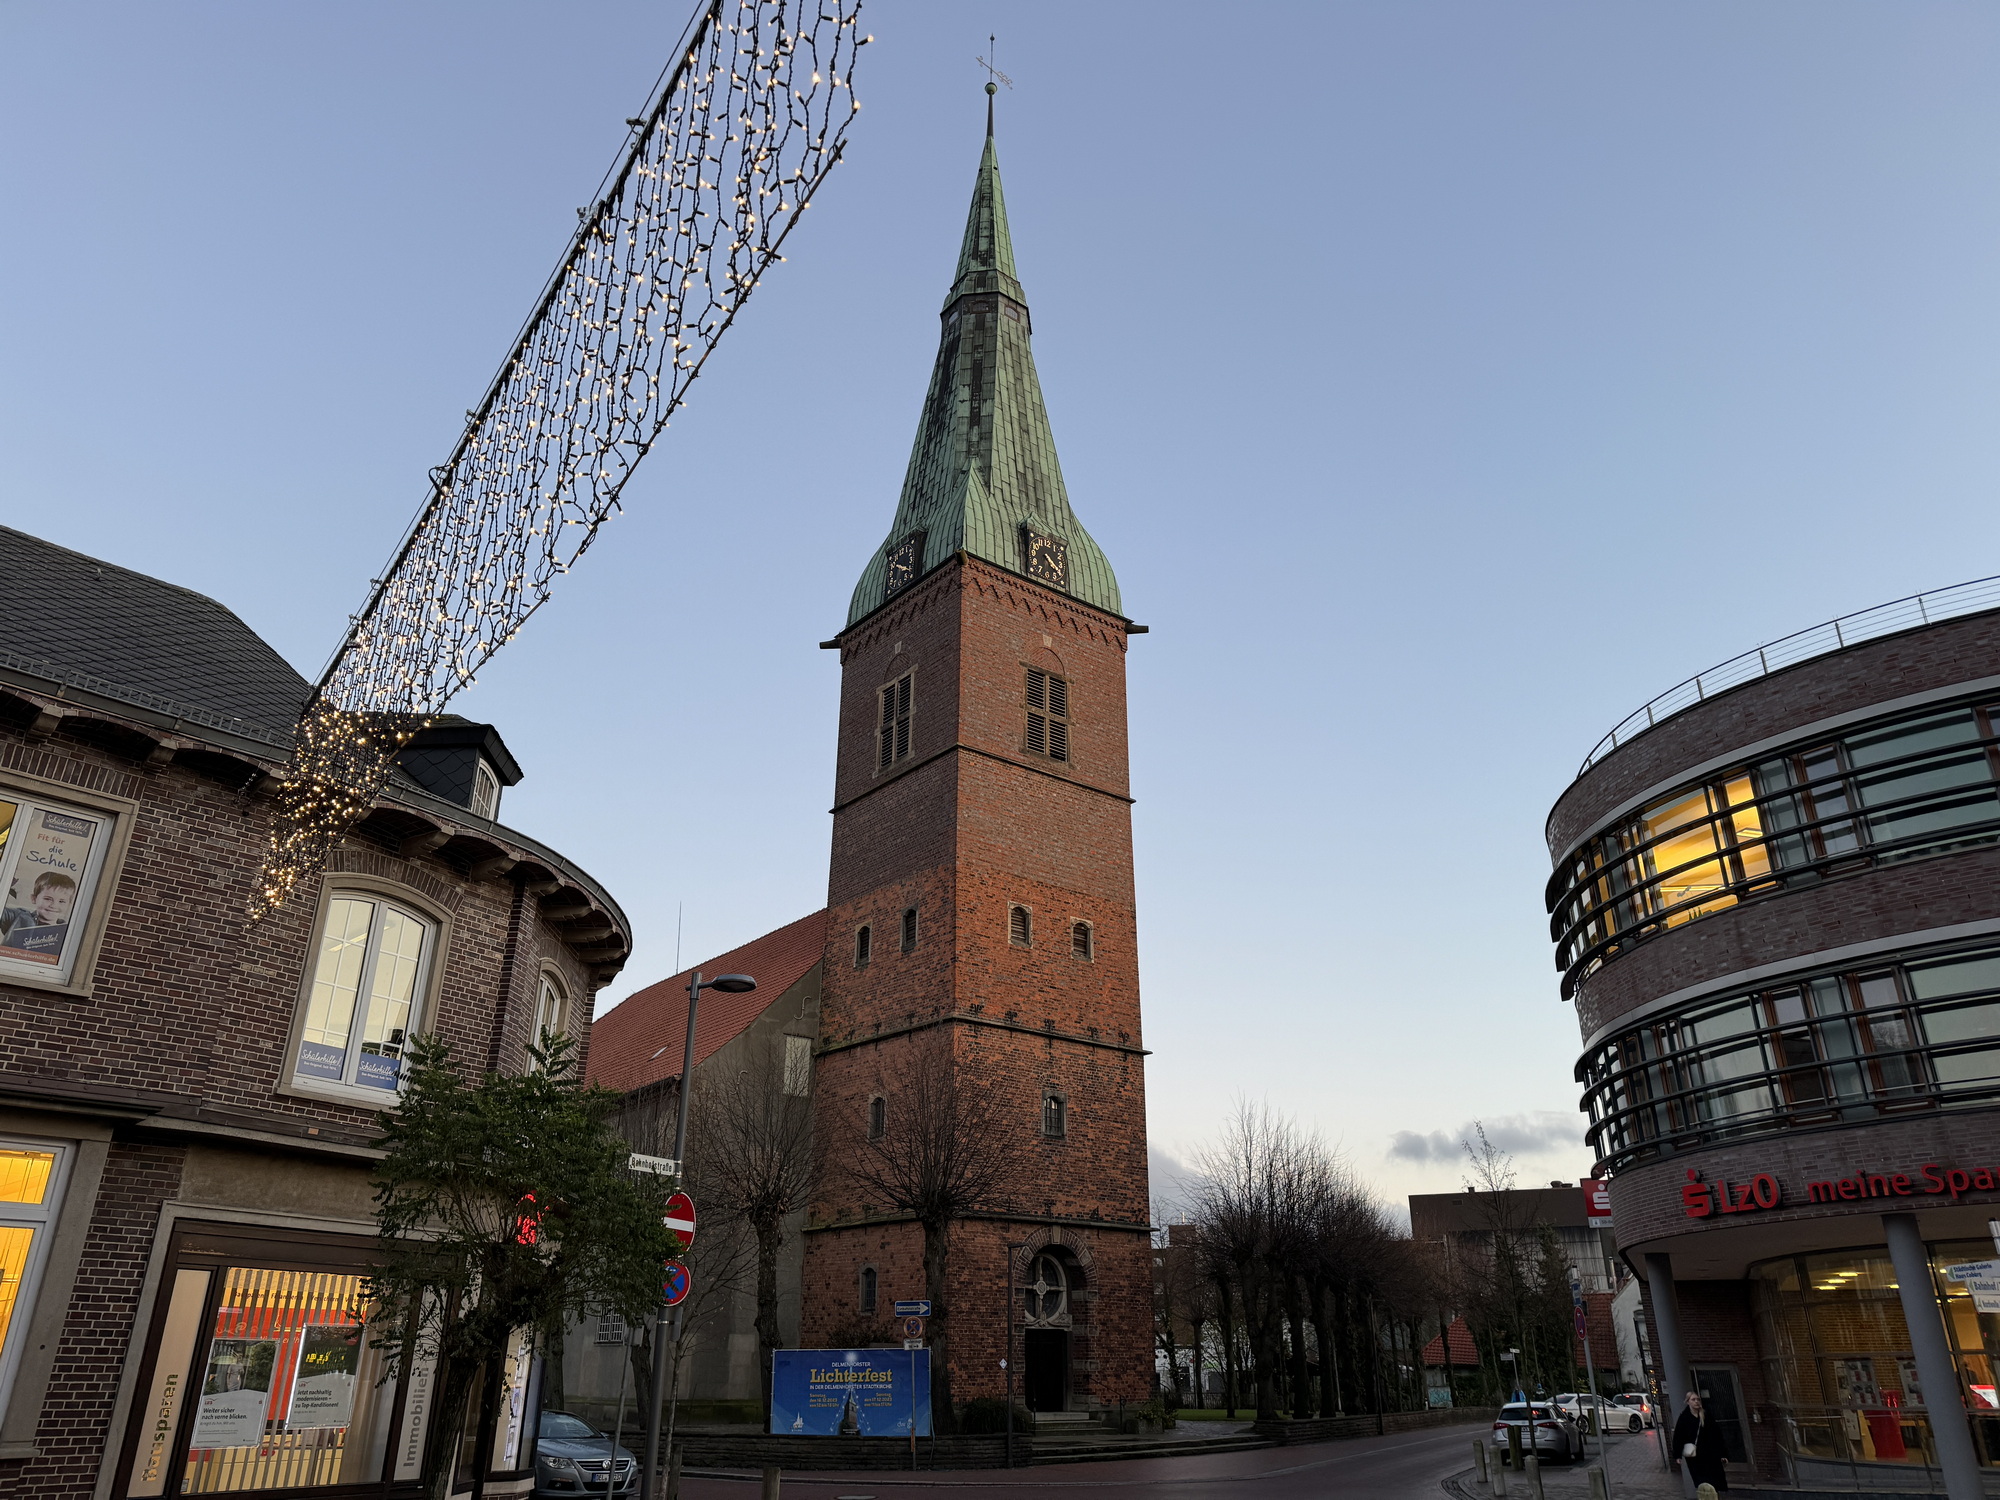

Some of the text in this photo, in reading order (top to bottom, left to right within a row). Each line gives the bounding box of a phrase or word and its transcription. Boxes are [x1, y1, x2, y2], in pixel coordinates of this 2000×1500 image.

[37, 834, 65, 844] Fit für
[49, 846, 63, 855] die
[26, 850, 77, 872] Schule
[301, 1049, 342, 1067] Schülerhilfe!
[1717, 1172, 1780, 1213] LzO
[1807, 1169, 1912, 1203] meine
[1920, 1164, 2000, 1200] Spa
[1953, 1264, 1976, 1272] Städtische
[1974, 1281, 1996, 1290] Bahnhof
[810, 1368, 892, 1383] Lichterfest
[403, 1367, 429, 1467] Immobilien
[142, 1374, 178, 1481] Bausparen
